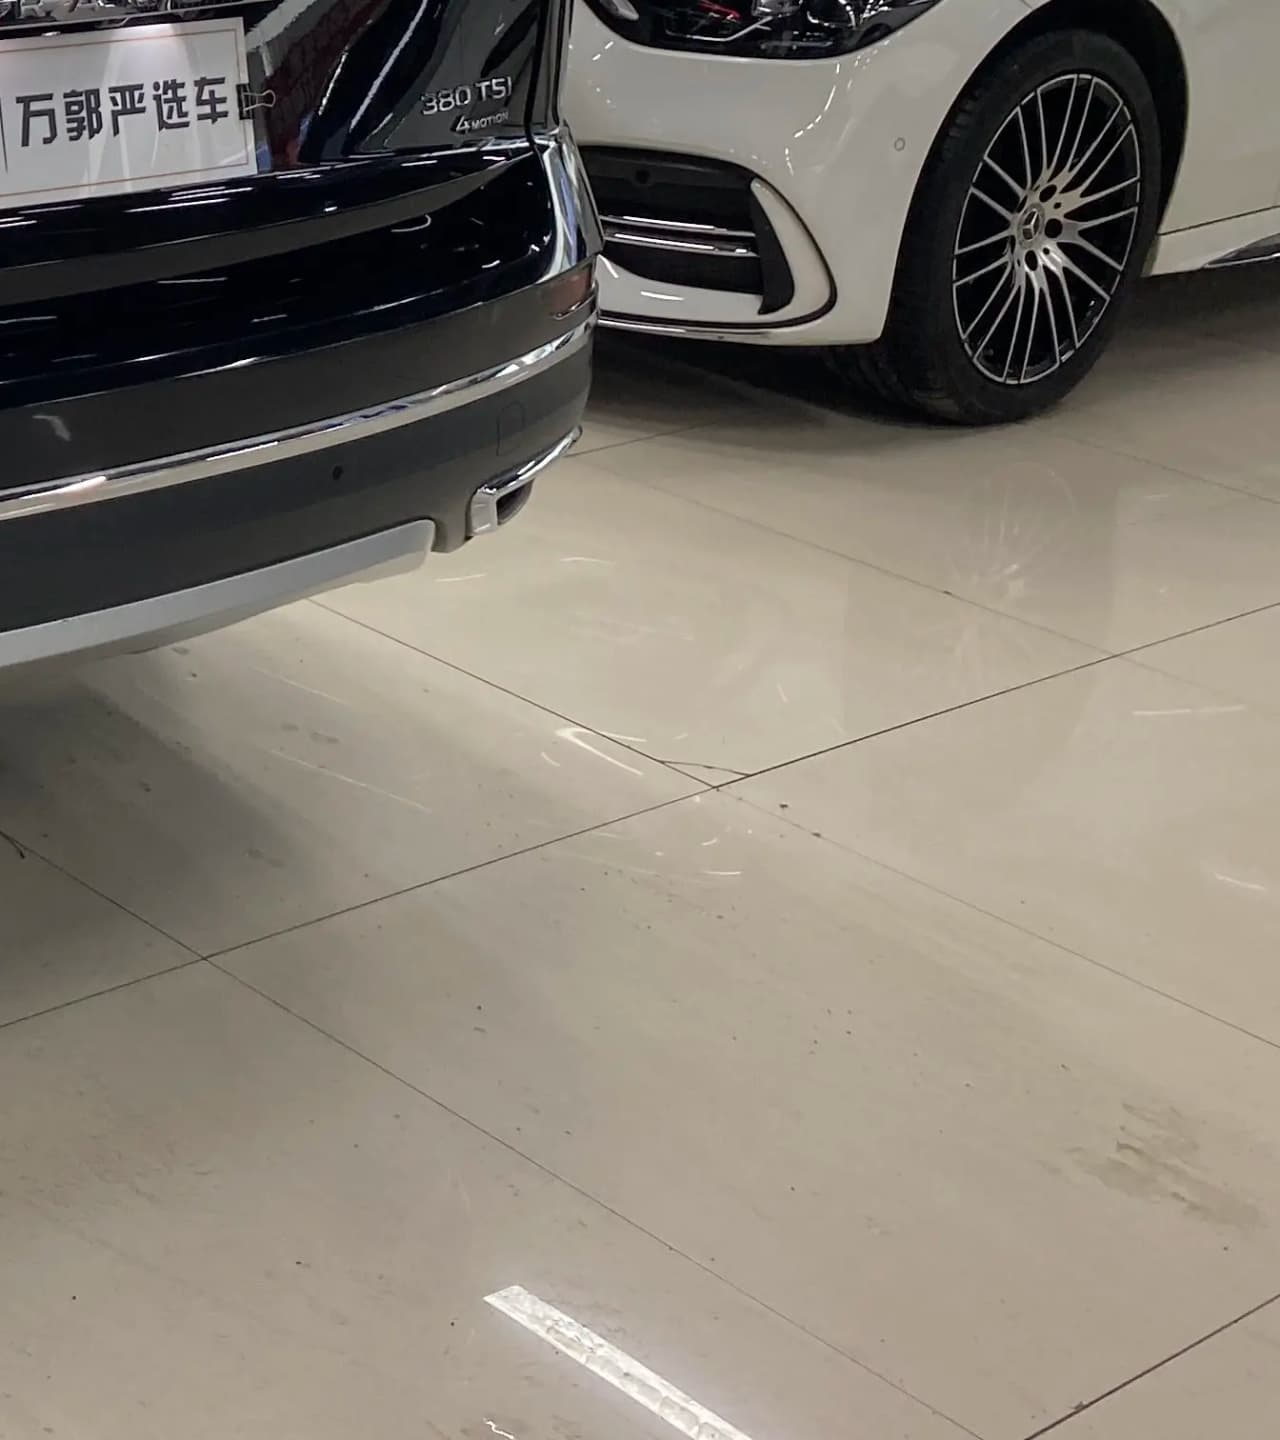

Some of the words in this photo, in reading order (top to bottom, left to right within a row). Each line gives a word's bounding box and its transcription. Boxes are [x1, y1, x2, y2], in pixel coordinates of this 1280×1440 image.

[15, 76, 229, 148] 万郭严选车
[420, 85, 472, 115] 380
[475, 76, 512, 101] TSI
